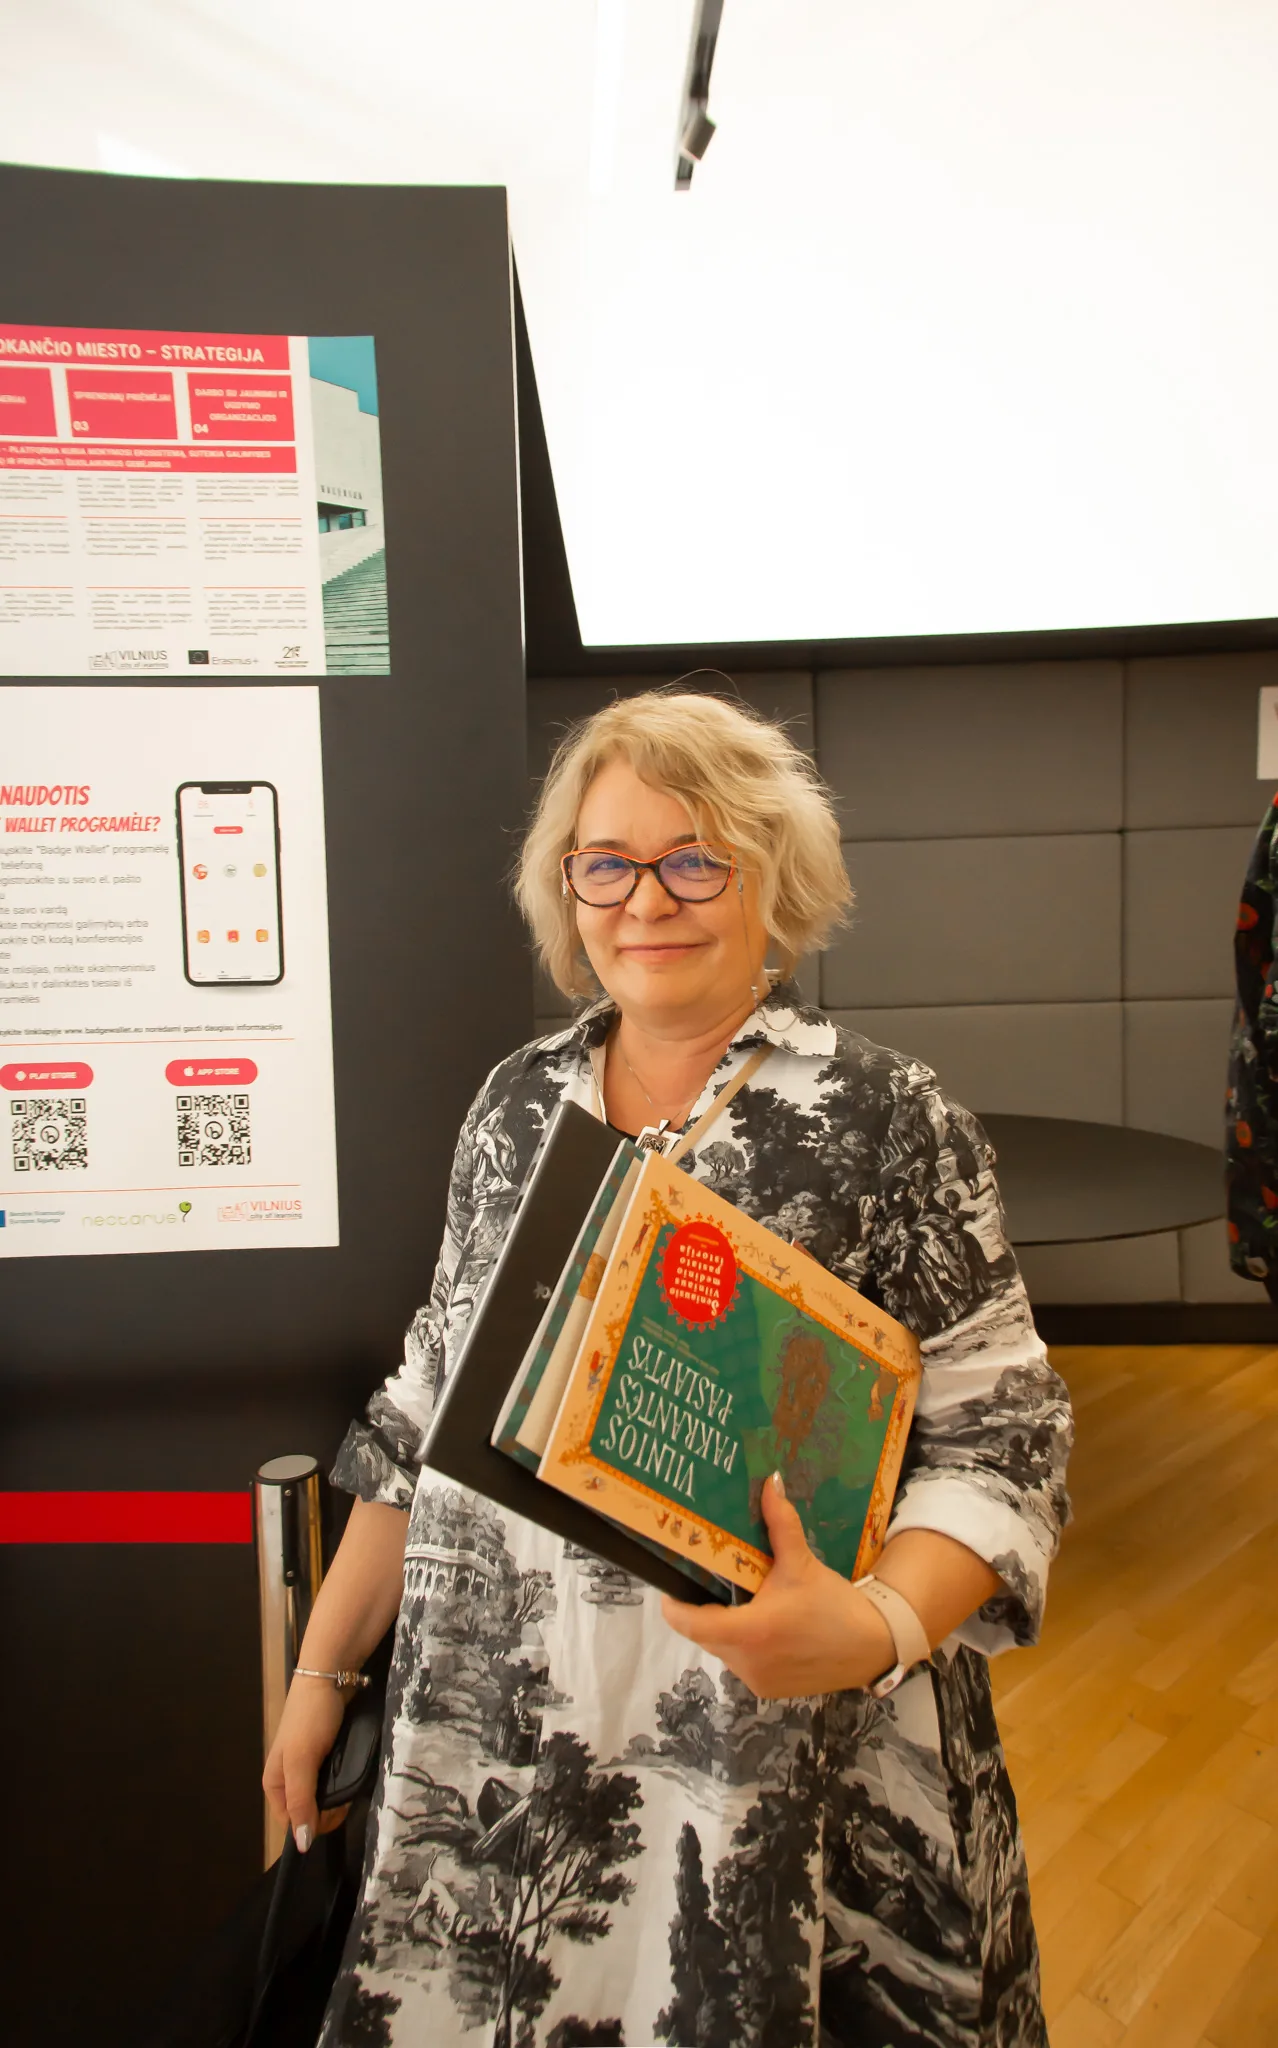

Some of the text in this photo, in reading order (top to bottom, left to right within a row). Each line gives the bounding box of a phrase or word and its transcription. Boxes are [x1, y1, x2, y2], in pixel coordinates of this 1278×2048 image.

[76, 341, 142, 360] MIESTO
[160, 344, 264, 363] STRATEGIJA
[73, 420, 89, 431] 03
[193, 423, 209, 434] 04
[118, 650, 168, 661] VILNIUS
[0, 785, 91, 806] NAUDOTIS
[5, 812, 161, 833] WALLET PROGRAMĖLE?
[13, 907, 38, 915] savo
[250, 1200, 302, 1211] VILNIUS
[82, 1213, 177, 1227] nectarus
[676, 1267, 721, 1286] medinio
[674, 1277, 720, 1299] Vilniaus
[627, 1335, 734, 1427] PASLAPTYS
[614, 1373, 740, 1475] PAKRANTĖS
[601, 1414, 696, 1502] VILNIOS
